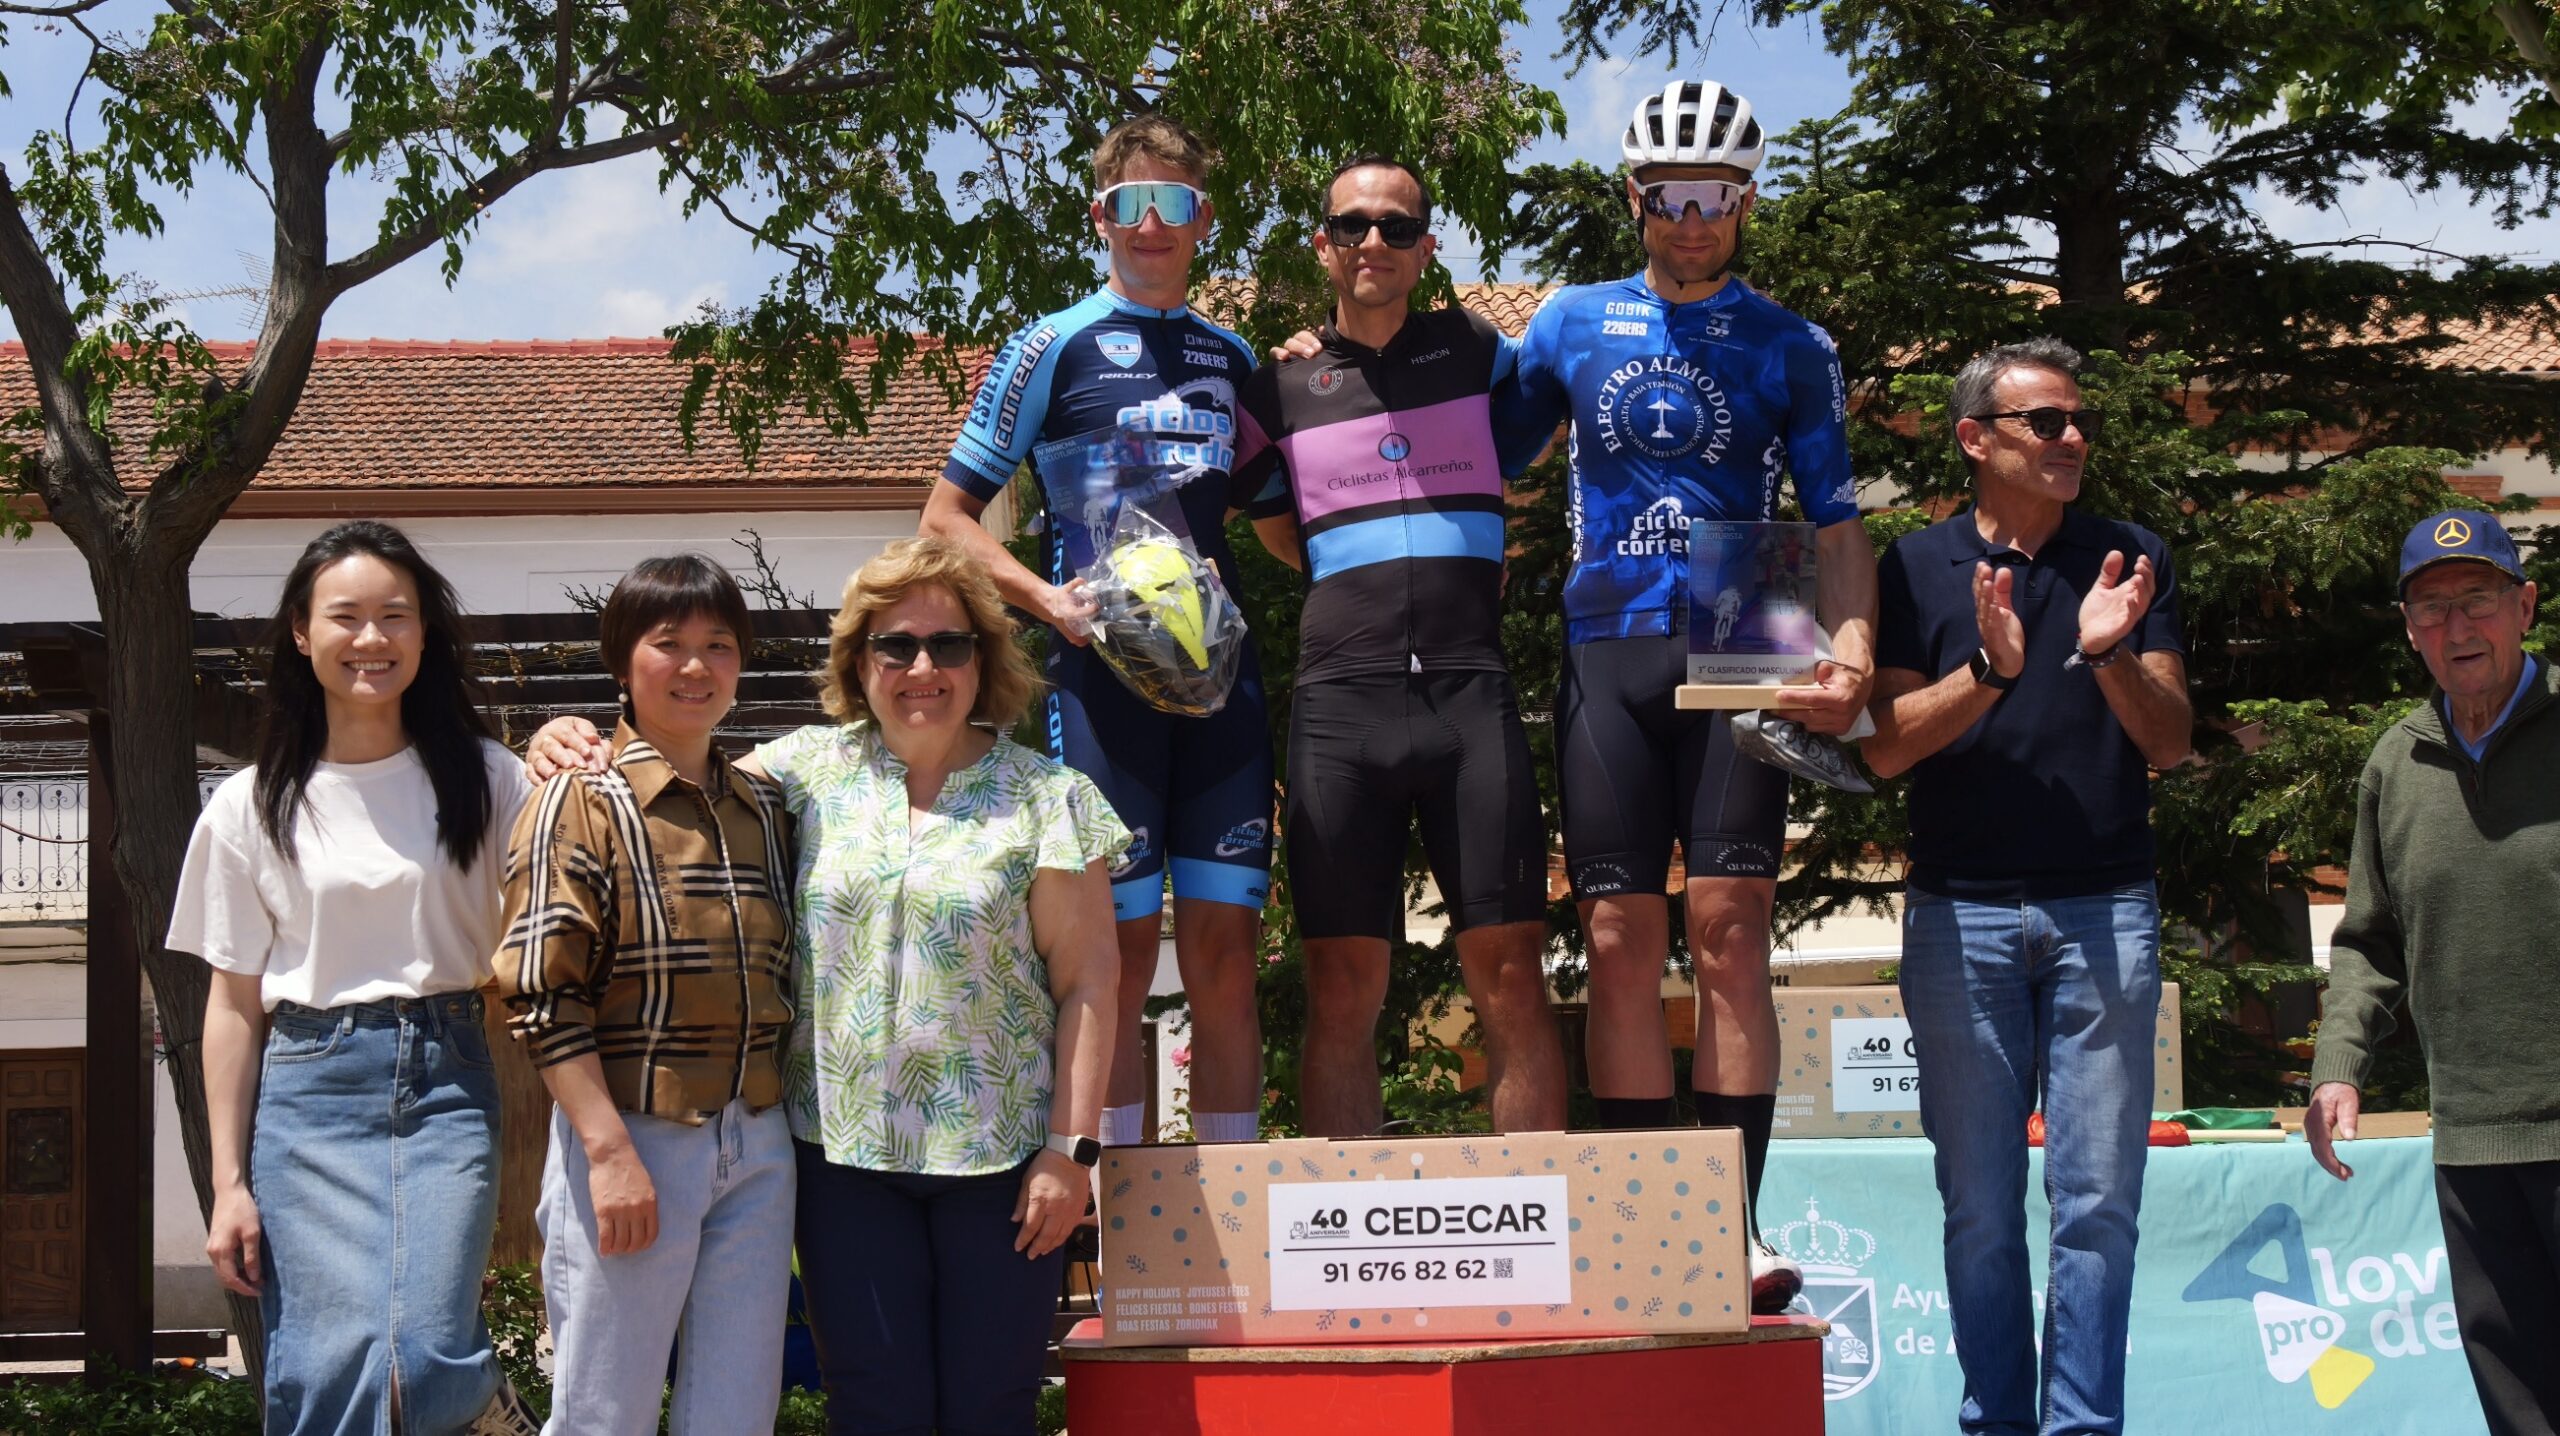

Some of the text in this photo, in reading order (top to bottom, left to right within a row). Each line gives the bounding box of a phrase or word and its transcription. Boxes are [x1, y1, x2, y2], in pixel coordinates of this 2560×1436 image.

[1605, 302, 1650, 317] GOBIK
[1602, 320, 1648, 336] 226ERS
[1182, 350, 1229, 370] 226ERS
[1410, 347, 1451, 366] HEMON
[993, 324, 1060, 450] corredor
[1628, 385, 1647, 400] BAJA
[1597, 360, 1644, 454] ELECTRO
[1648, 356, 1732, 465] ALMODOVAR
[1119, 402, 1231, 437] ciclos
[1046, 440, 1077, 454] MARCHA
[1327, 458, 1474, 491] Ciclistas Alcarreños
[1633, 510, 1705, 531] ciclo
[1617, 539, 1690, 556] corre
[1708, 666, 1757, 674] CLASIFICADO
[1758, 666, 1804, 674] MASCULINO
[1727, 863, 1765, 872] QUESOS
[1586, 881, 1621, 893] QUESOS
[1863, 1037, 1891, 1053] 40
[1872, 1076, 1920, 1093] 91 67
[1310, 1208, 1347, 1229] 40
[1364, 1203, 1547, 1236] CEDECAR
[1309, 1229, 1350, 1237] ANIVERSARIO
[1323, 1259, 1487, 1283] 91 676 82 62
[1116, 1288, 1141, 1299] HAPPY
[1143, 1287, 1181, 1299] HOLIDAYS
[1186, 1286, 1226, 1298] JOYEUSES
[1116, 1301, 1248, 1316] FELICES FIESTAS BONES FESTES
[1116, 1318, 1218, 1332] BOAS FESTAS ZORIONAK
[1895, 1328, 1935, 1355] de
[2264, 1315, 2334, 1356] pro
